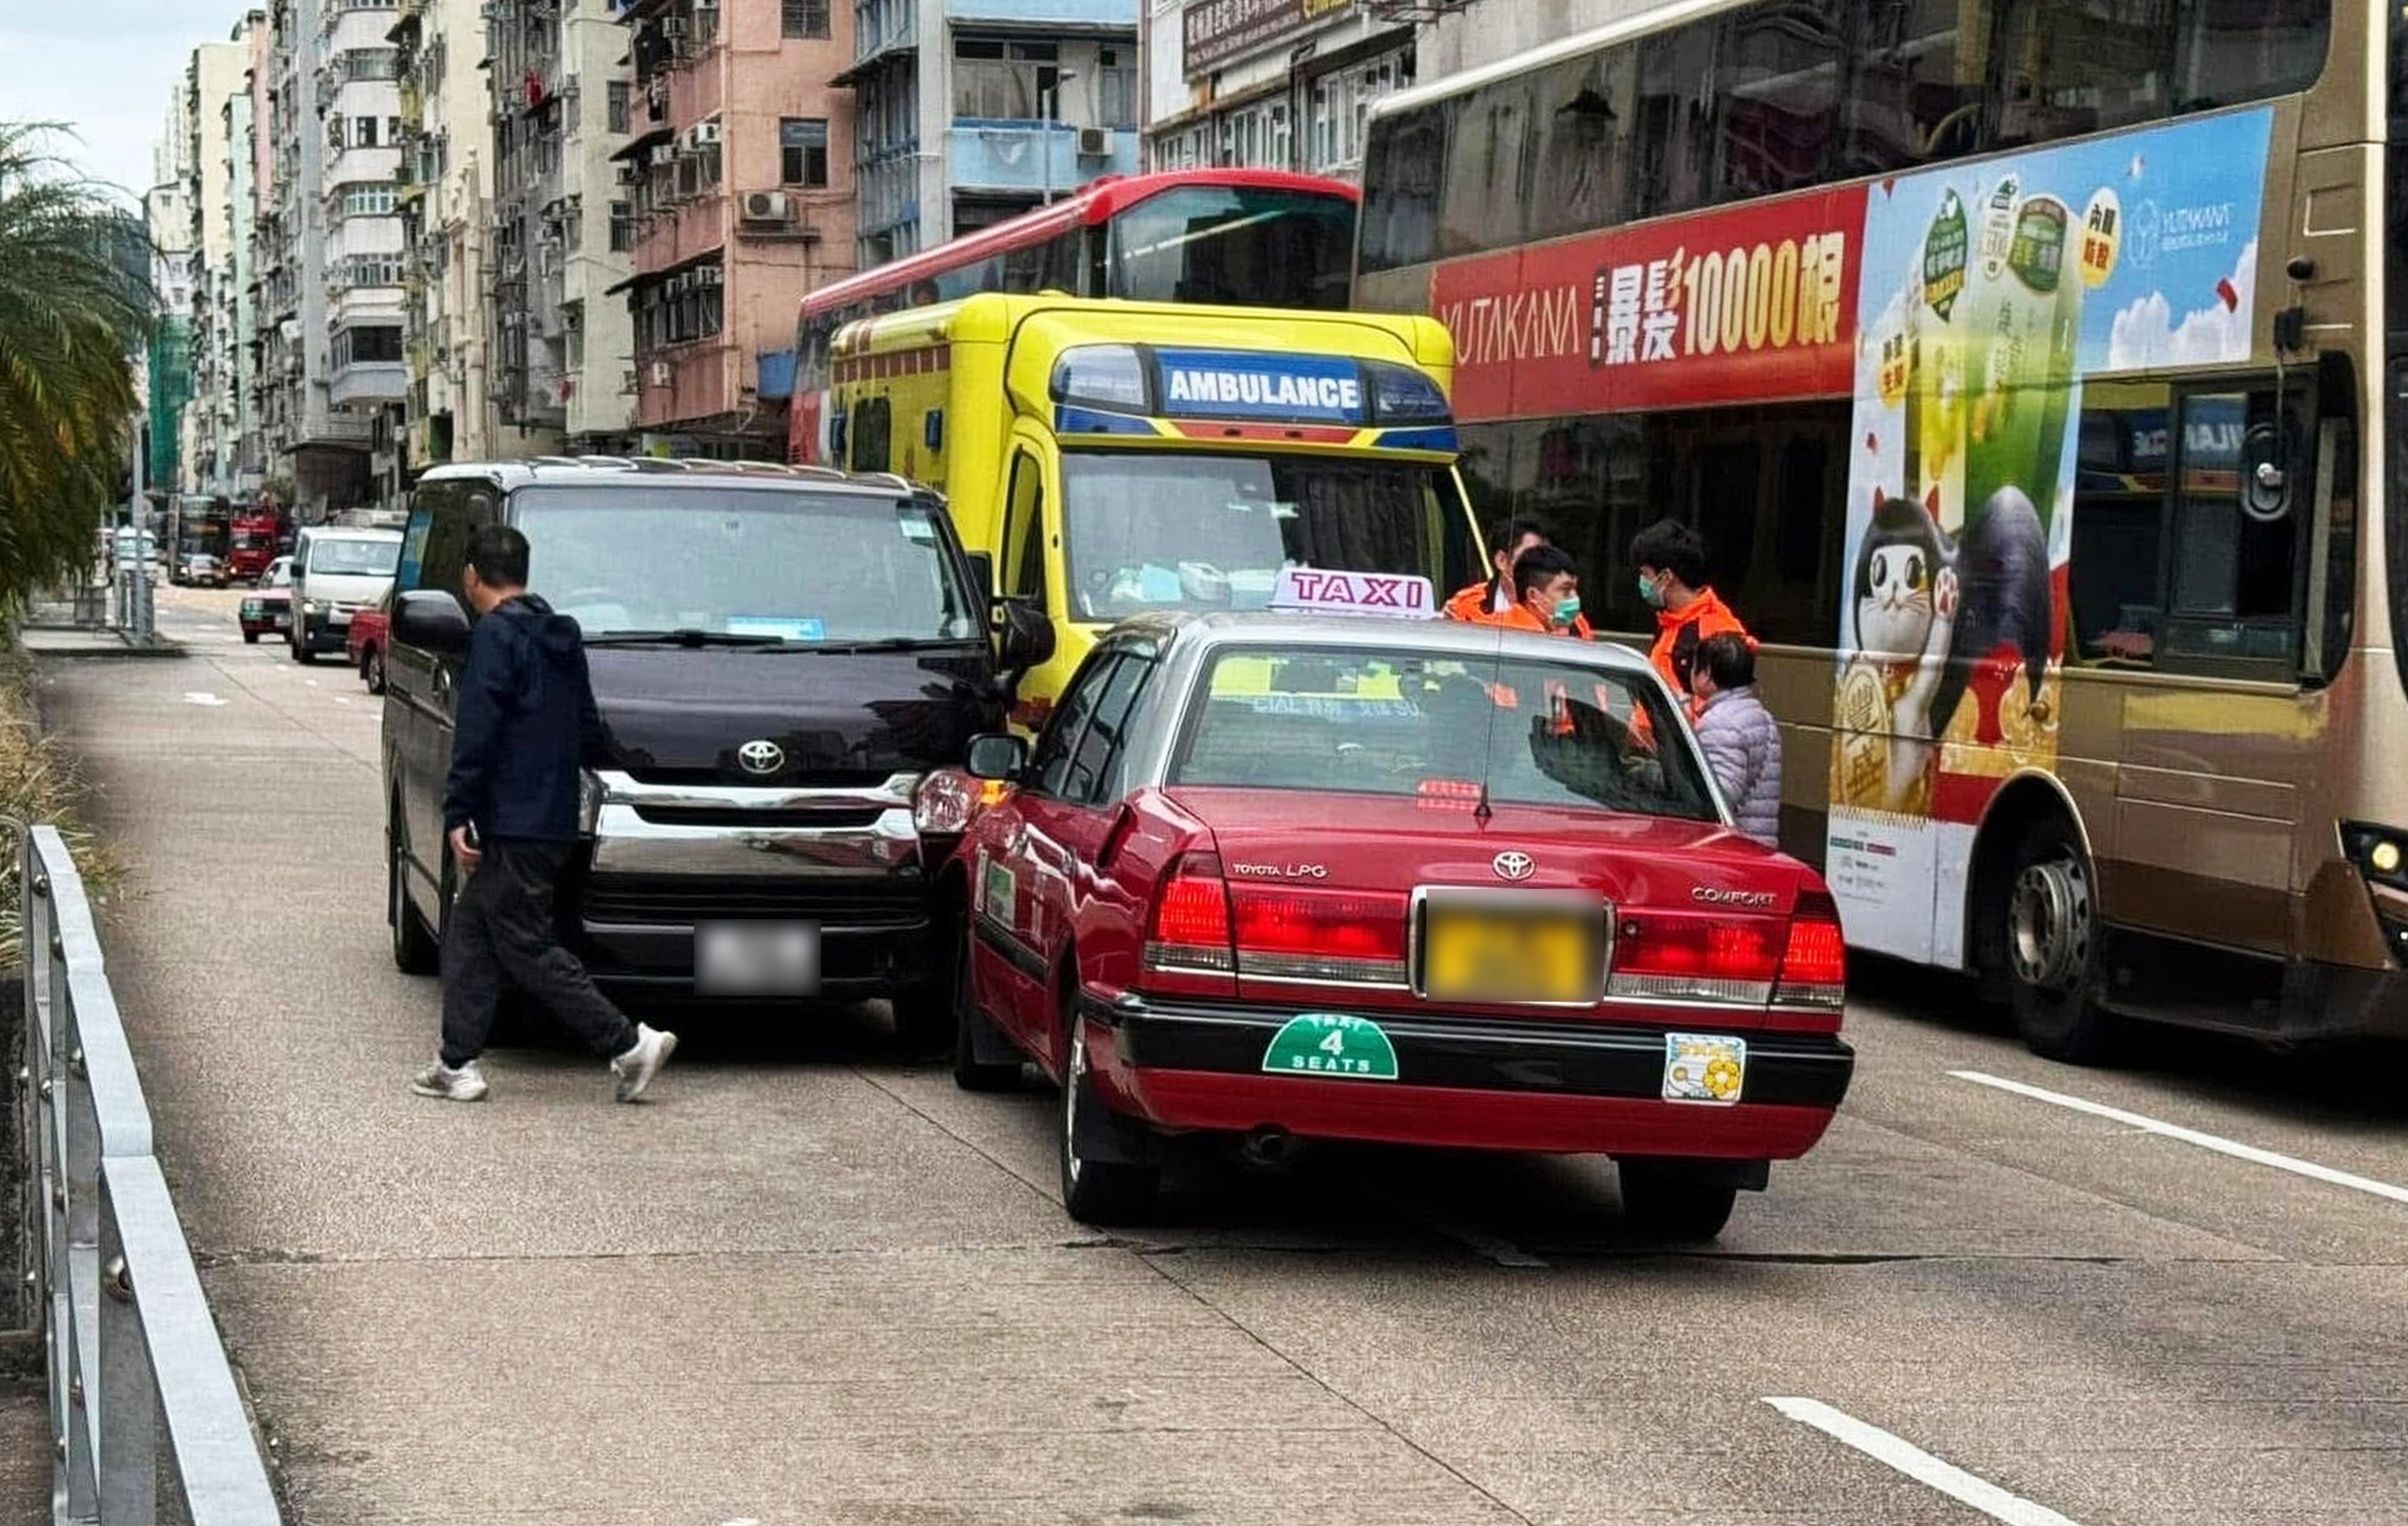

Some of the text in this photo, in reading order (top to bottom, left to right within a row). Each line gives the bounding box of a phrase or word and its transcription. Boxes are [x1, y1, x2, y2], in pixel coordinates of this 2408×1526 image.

[1442, 284, 1580, 366] YUTAKANA
[1169, 370, 1362, 409] AMBULANCE
[1292, 572, 1422, 608] TAXI
[1233, 864, 1328, 877] TOYOTA LPG
[1692, 887, 1777, 907] COMFORT
[1319, 1029, 1344, 1055] 4
[1292, 1056, 1370, 1072] SEATS
